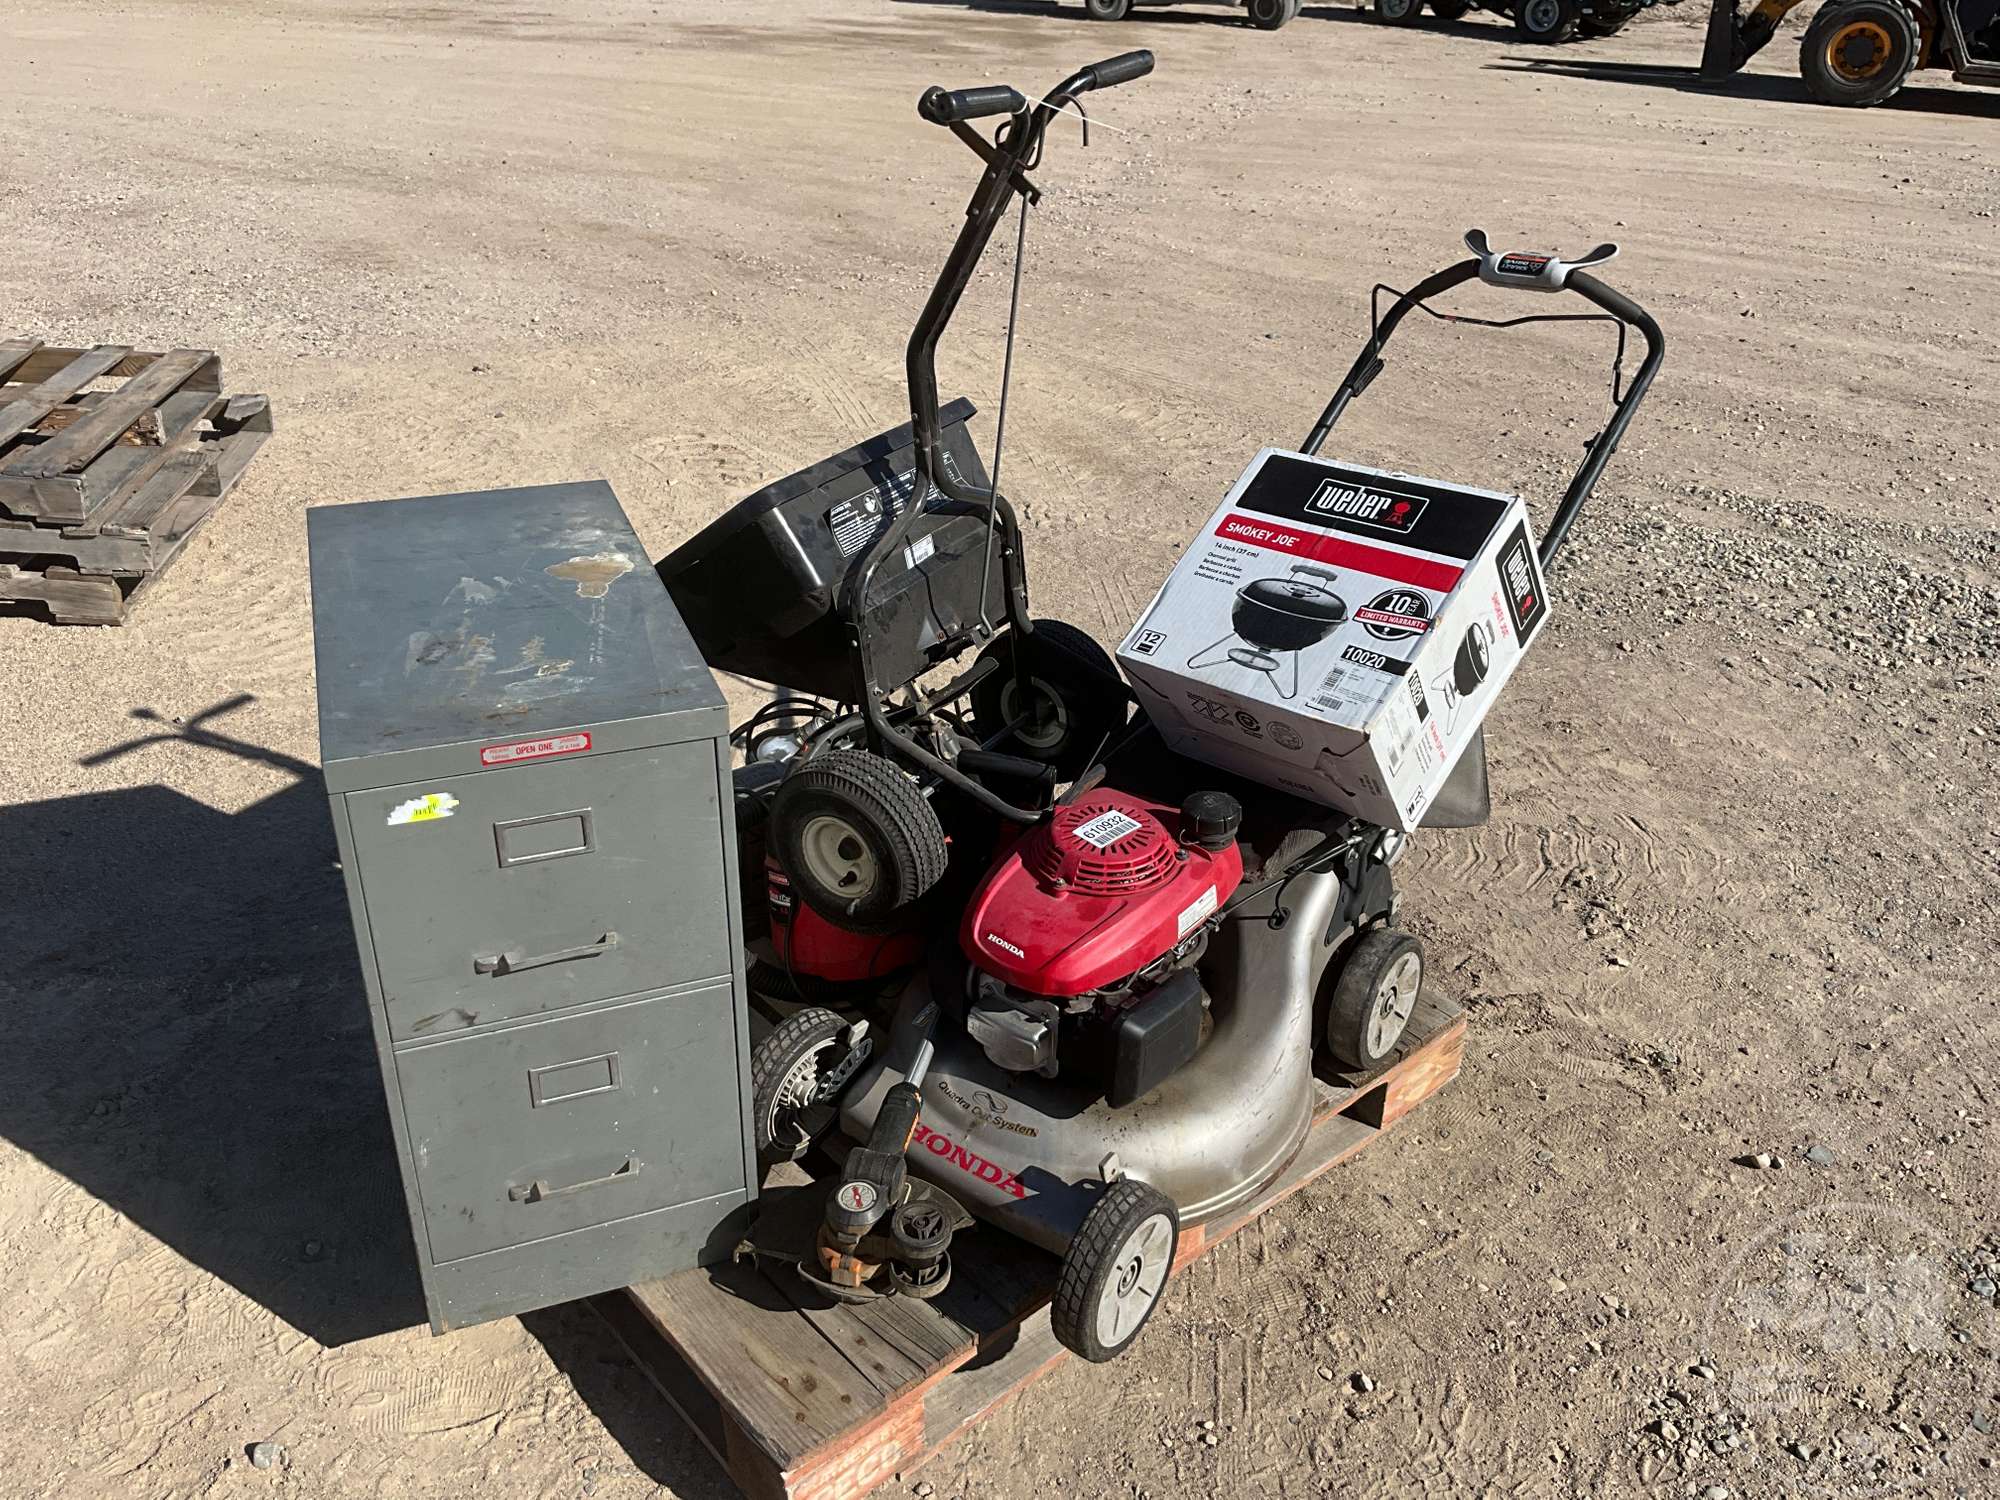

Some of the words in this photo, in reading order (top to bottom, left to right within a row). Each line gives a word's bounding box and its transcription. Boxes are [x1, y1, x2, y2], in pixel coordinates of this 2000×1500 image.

[1316, 486, 1392, 519] weber
[1226, 522, 1274, 541] SMOKEY
[1222, 544, 1236, 553] inch
[1507, 548, 1531, 602] weber
[1385, 594, 1411, 614] 10
[1405, 599, 1421, 616] YEAR
[1360, 610, 1387, 622] LIMITED
[1388, 615, 1425, 629] WARRANTY
[1144, 632, 1161, 644] 12
[1344, 646, 1387, 669] 10020
[1408, 673, 1425, 706] 10020
[515, 745, 536, 755] OPEN
[538, 742, 553, 752] ONE
[1083, 815, 1126, 839] 610932
[987, 933, 1025, 959] HONDA
[938, 1081, 971, 1110] Quadra
[992, 1115, 1038, 1138] System
